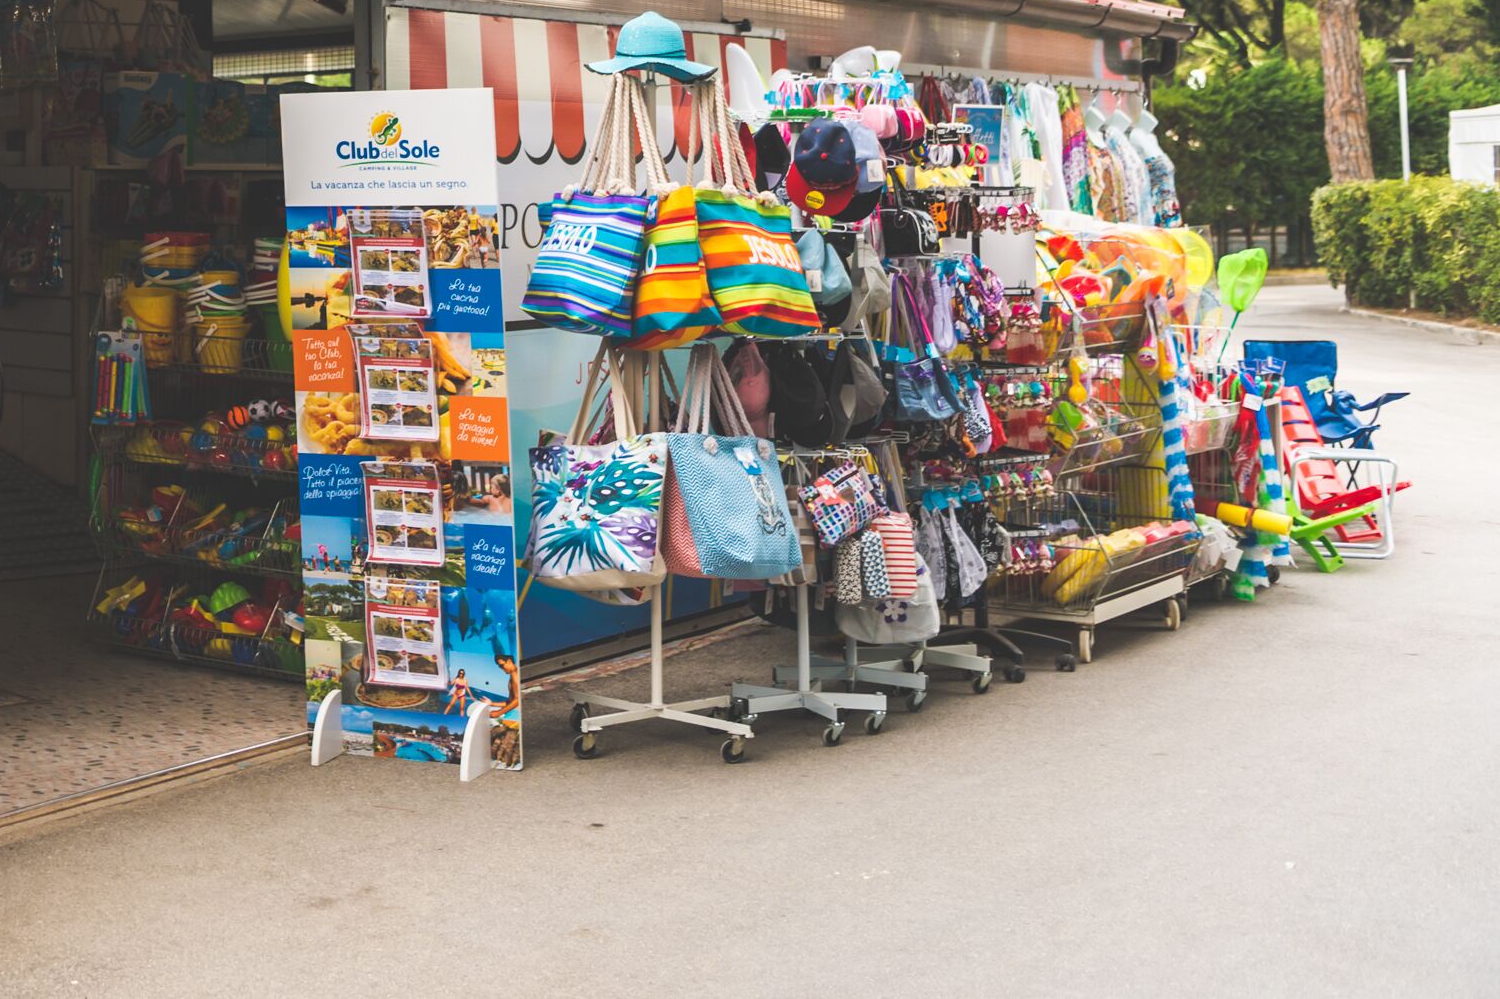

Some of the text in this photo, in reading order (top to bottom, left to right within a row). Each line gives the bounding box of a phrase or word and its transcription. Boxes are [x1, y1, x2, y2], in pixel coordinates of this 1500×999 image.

[336, 139, 440, 160] Club del Sole
[311, 180, 322, 189] La
[325, 181, 364, 189] vacanza
[367, 180, 385, 189] che
[388, 180, 417, 189] lascia
[420, 181, 433, 189] un
[541, 224, 598, 254] JESOLO
[741, 234, 801, 272] JESOLO
[448, 278, 465, 290] La
[458, 408, 475, 420] La
[303, 465, 332, 478] Dolce
[303, 488, 323, 500] della
[472, 538, 488, 551] La
